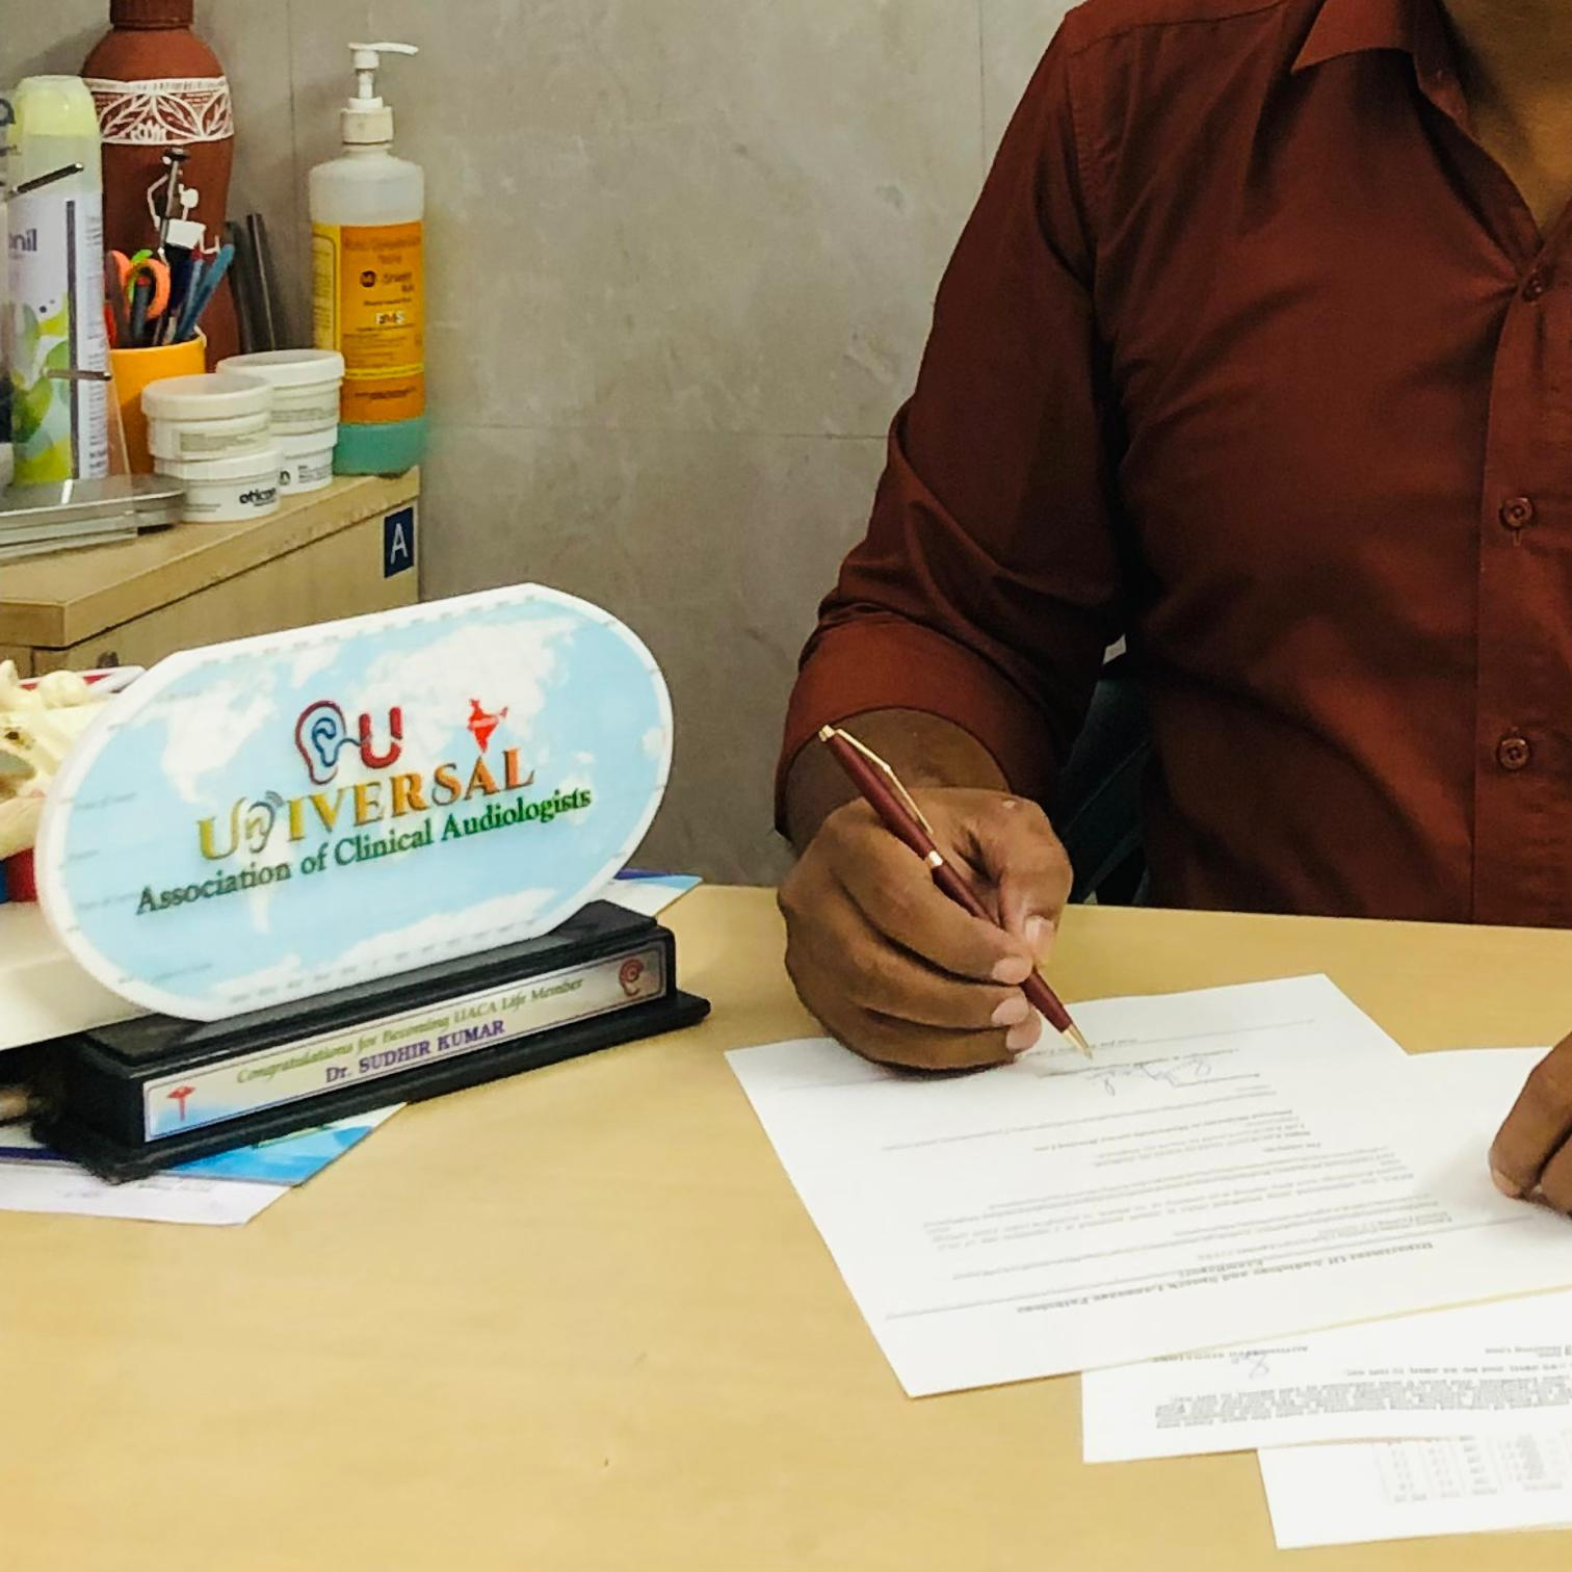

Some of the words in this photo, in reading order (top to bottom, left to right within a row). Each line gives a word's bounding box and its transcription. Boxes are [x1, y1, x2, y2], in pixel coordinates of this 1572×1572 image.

[390, 523, 409, 565] A
[135, 862, 292, 916] Association
[300, 842, 329, 875] of
[333, 817, 434, 866] Clinical
[441, 787, 592, 842] Audiologists
[236, 1042, 354, 1084] Congratulations
[356, 1034, 378, 1055] for
[453, 1001, 497, 1025] UACA
[501, 992, 527, 1013] Life
[531, 978, 583, 1003] Member
[325, 1065, 352, 1084] Dr.
[358, 1040, 431, 1074] SUDHIR
[437, 1020, 505, 1052] KUMAR
